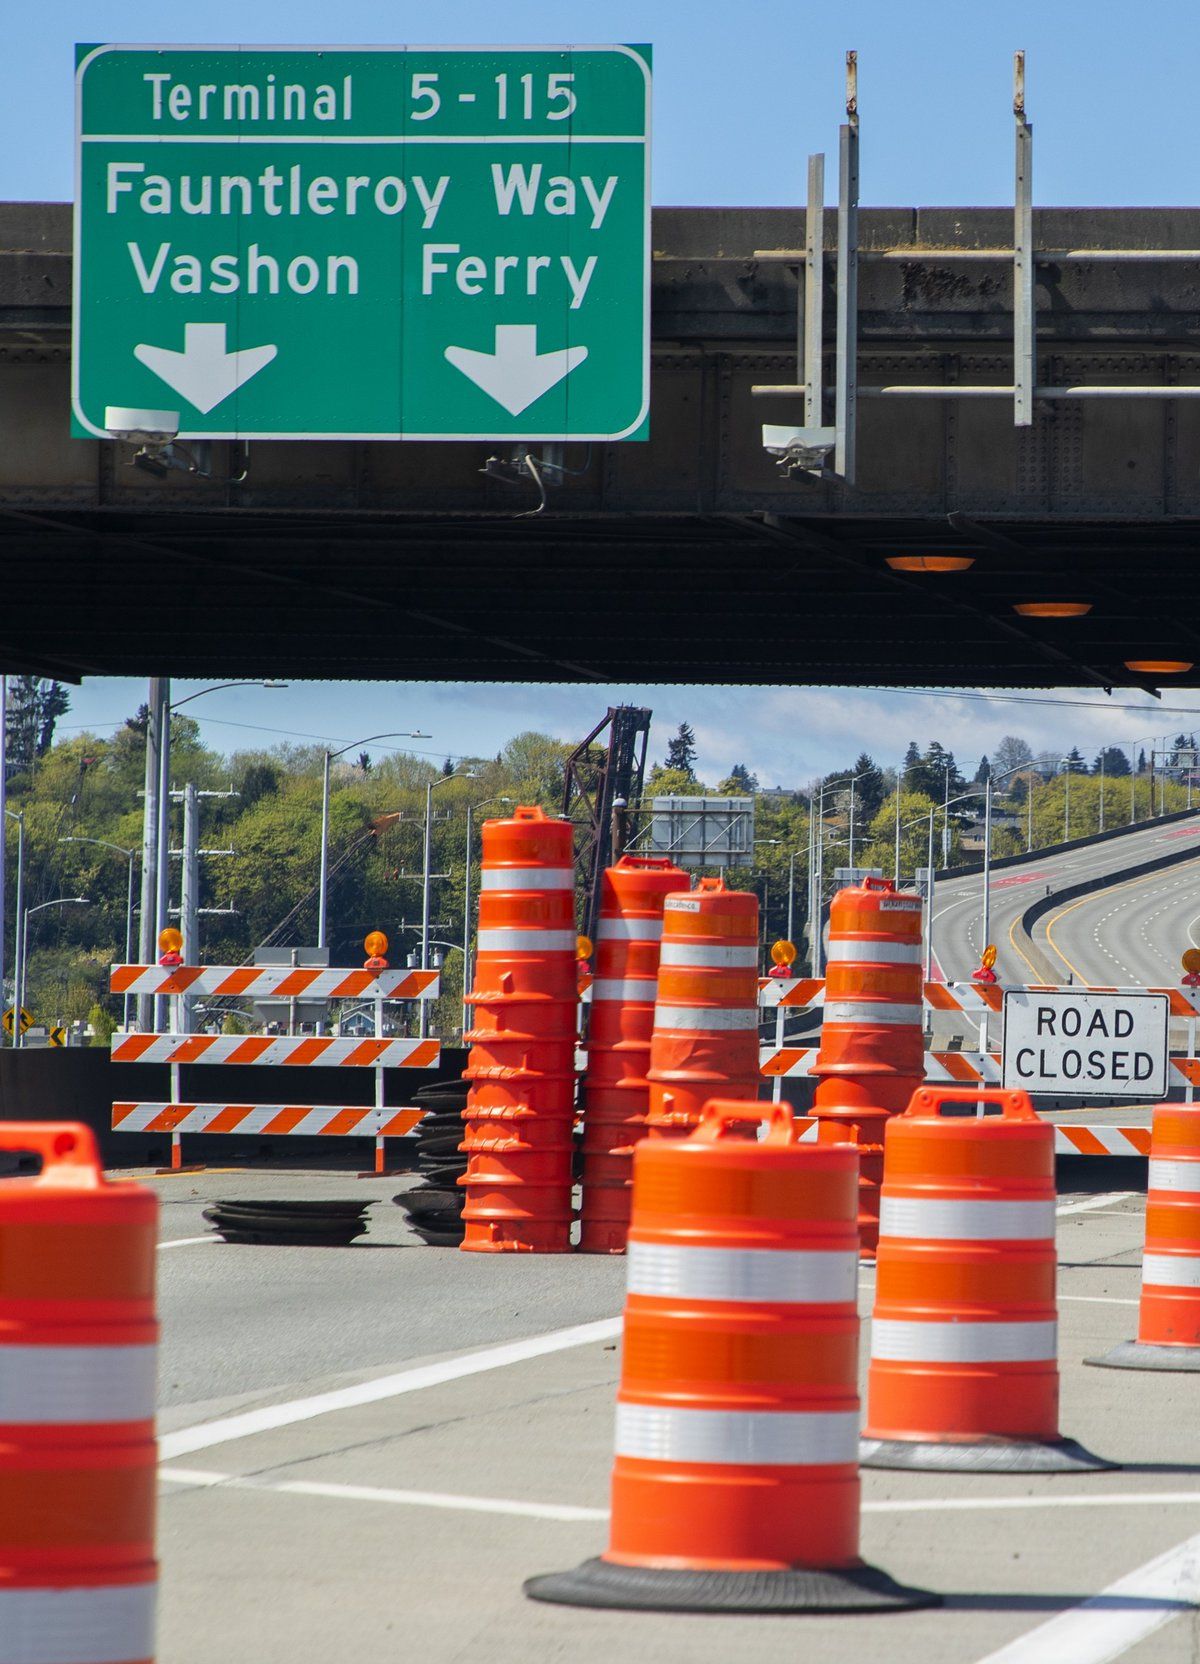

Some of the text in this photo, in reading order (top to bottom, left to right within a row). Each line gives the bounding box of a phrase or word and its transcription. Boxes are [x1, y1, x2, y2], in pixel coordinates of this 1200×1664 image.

[144, 73, 351, 120] Terminal
[107, 162, 618, 229] Fauntleroy Way
[128, 242, 598, 309] Vashon Ferry
[1036, 1006, 1134, 1038] ROAD
[1015, 1047, 1154, 1081] CLOSED
